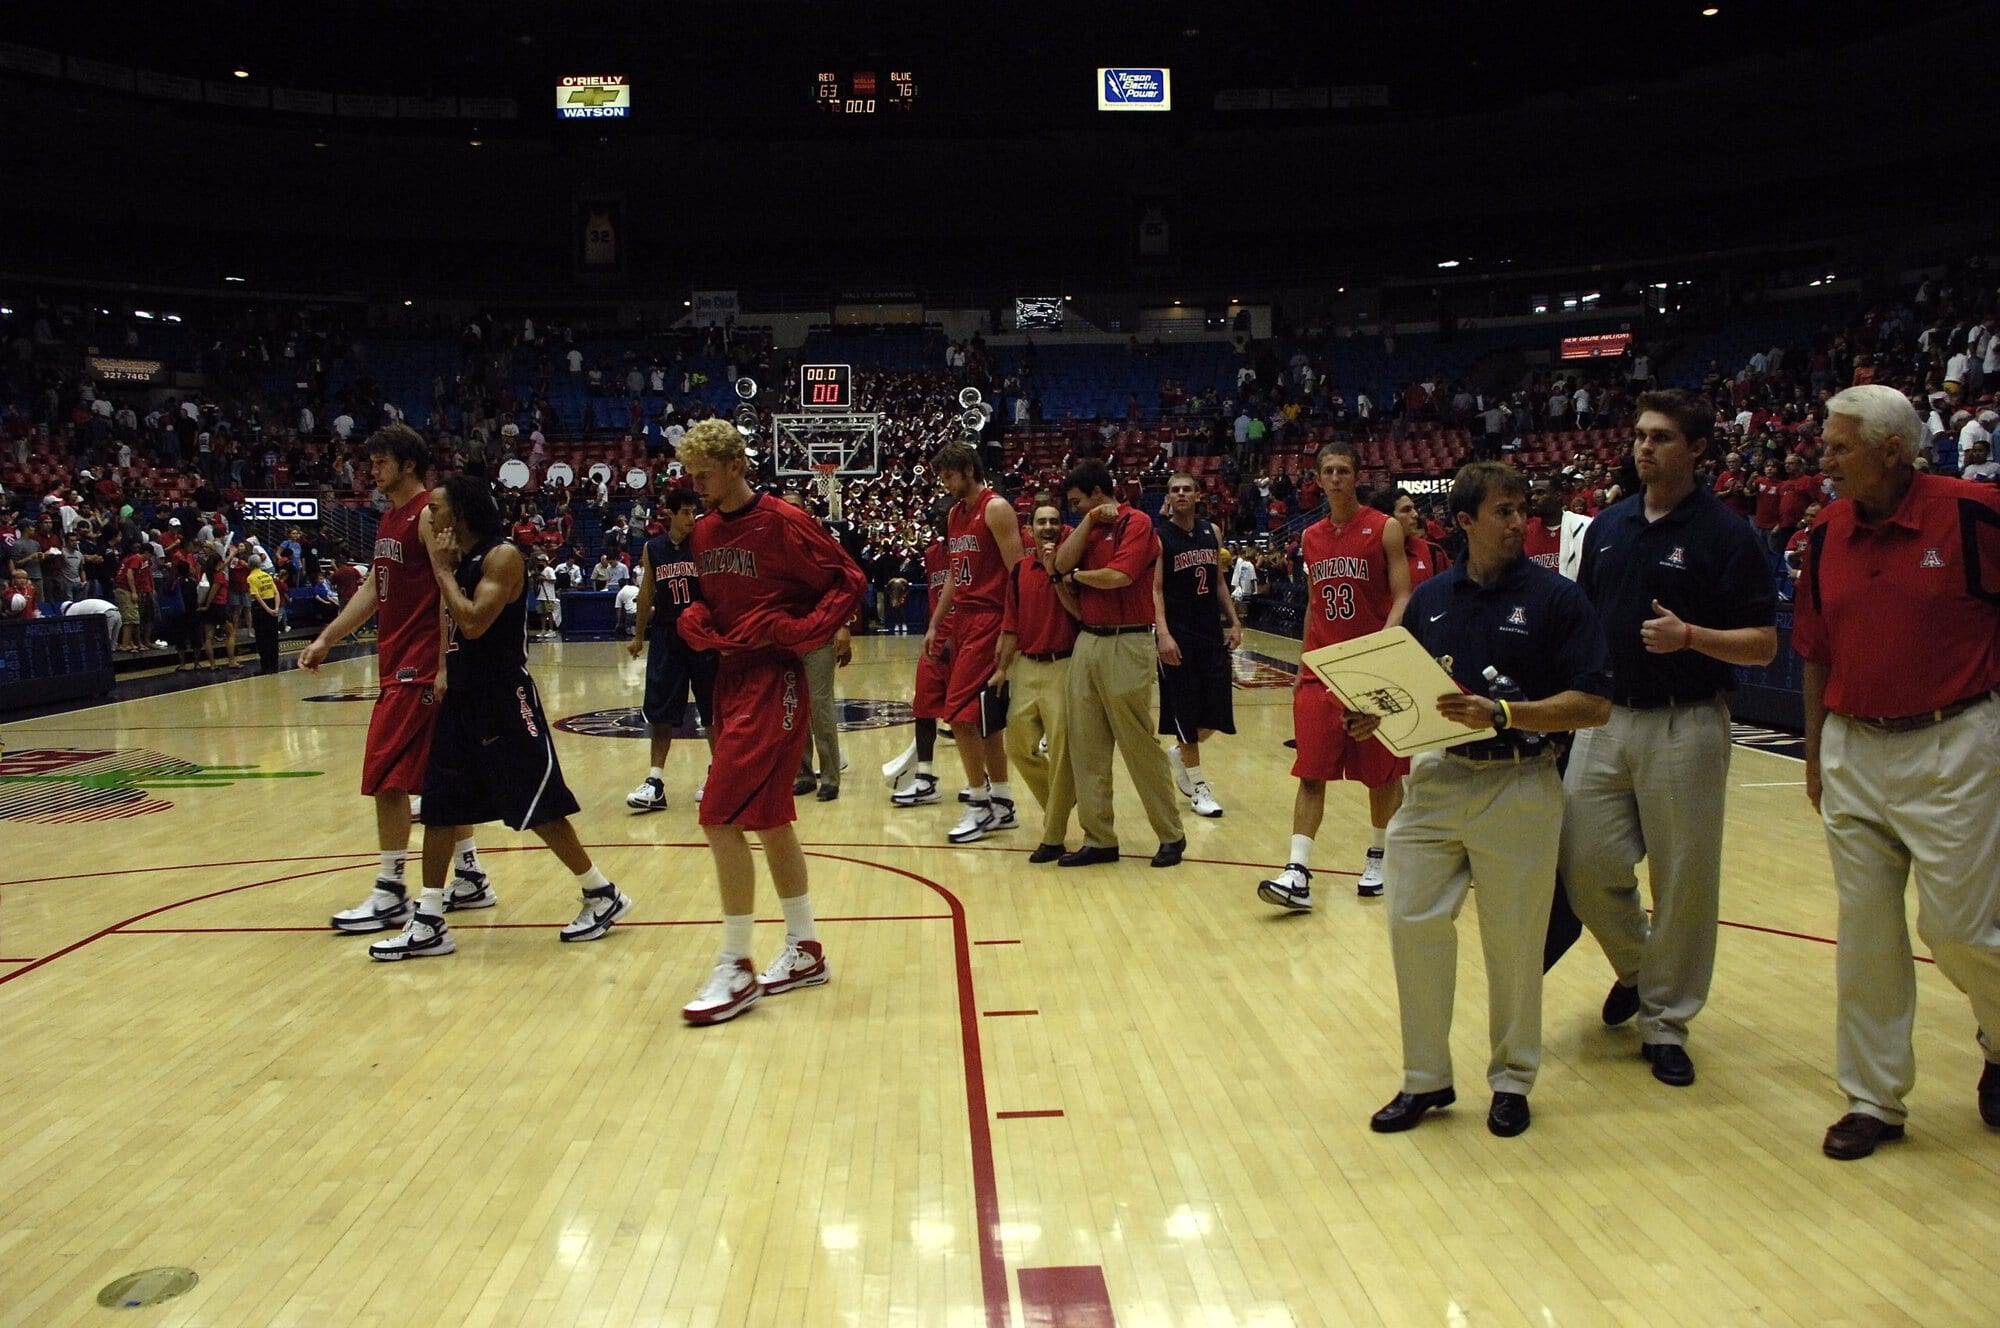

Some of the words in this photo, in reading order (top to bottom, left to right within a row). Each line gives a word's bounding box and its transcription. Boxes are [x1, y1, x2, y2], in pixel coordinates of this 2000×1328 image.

[562, 76, 623, 86] O'RIELLY
[818, 73, 835, 82] RED
[890, 72, 912, 81] BLUE
[1118, 73, 1152, 82] Tucson
[820, 84, 837, 98] 63
[896, 83, 913, 97] 76
[1122, 81, 1158, 90] Electric
[1125, 89, 1159, 98] Power
[563, 107, 625, 118] WATSON
[845, 99, 876, 113] 00.0
[590, 230, 609, 243] 32
[103, 371, 150, 381] 327-7463
[807, 369, 836, 381] 00.0
[813, 384, 839, 402] 00
[1396, 479, 1440, 495] MUSCLE
[1174, 548, 1218, 573] ARIZON
[1310, 556, 1369, 586] ARIZONA
[1195, 566, 1209, 595] 2
[668, 578, 690, 605] 11
[1322, 583, 1355, 621] 33
[783, 671, 798, 730] CATS
[516, 686, 539, 738] CATS
